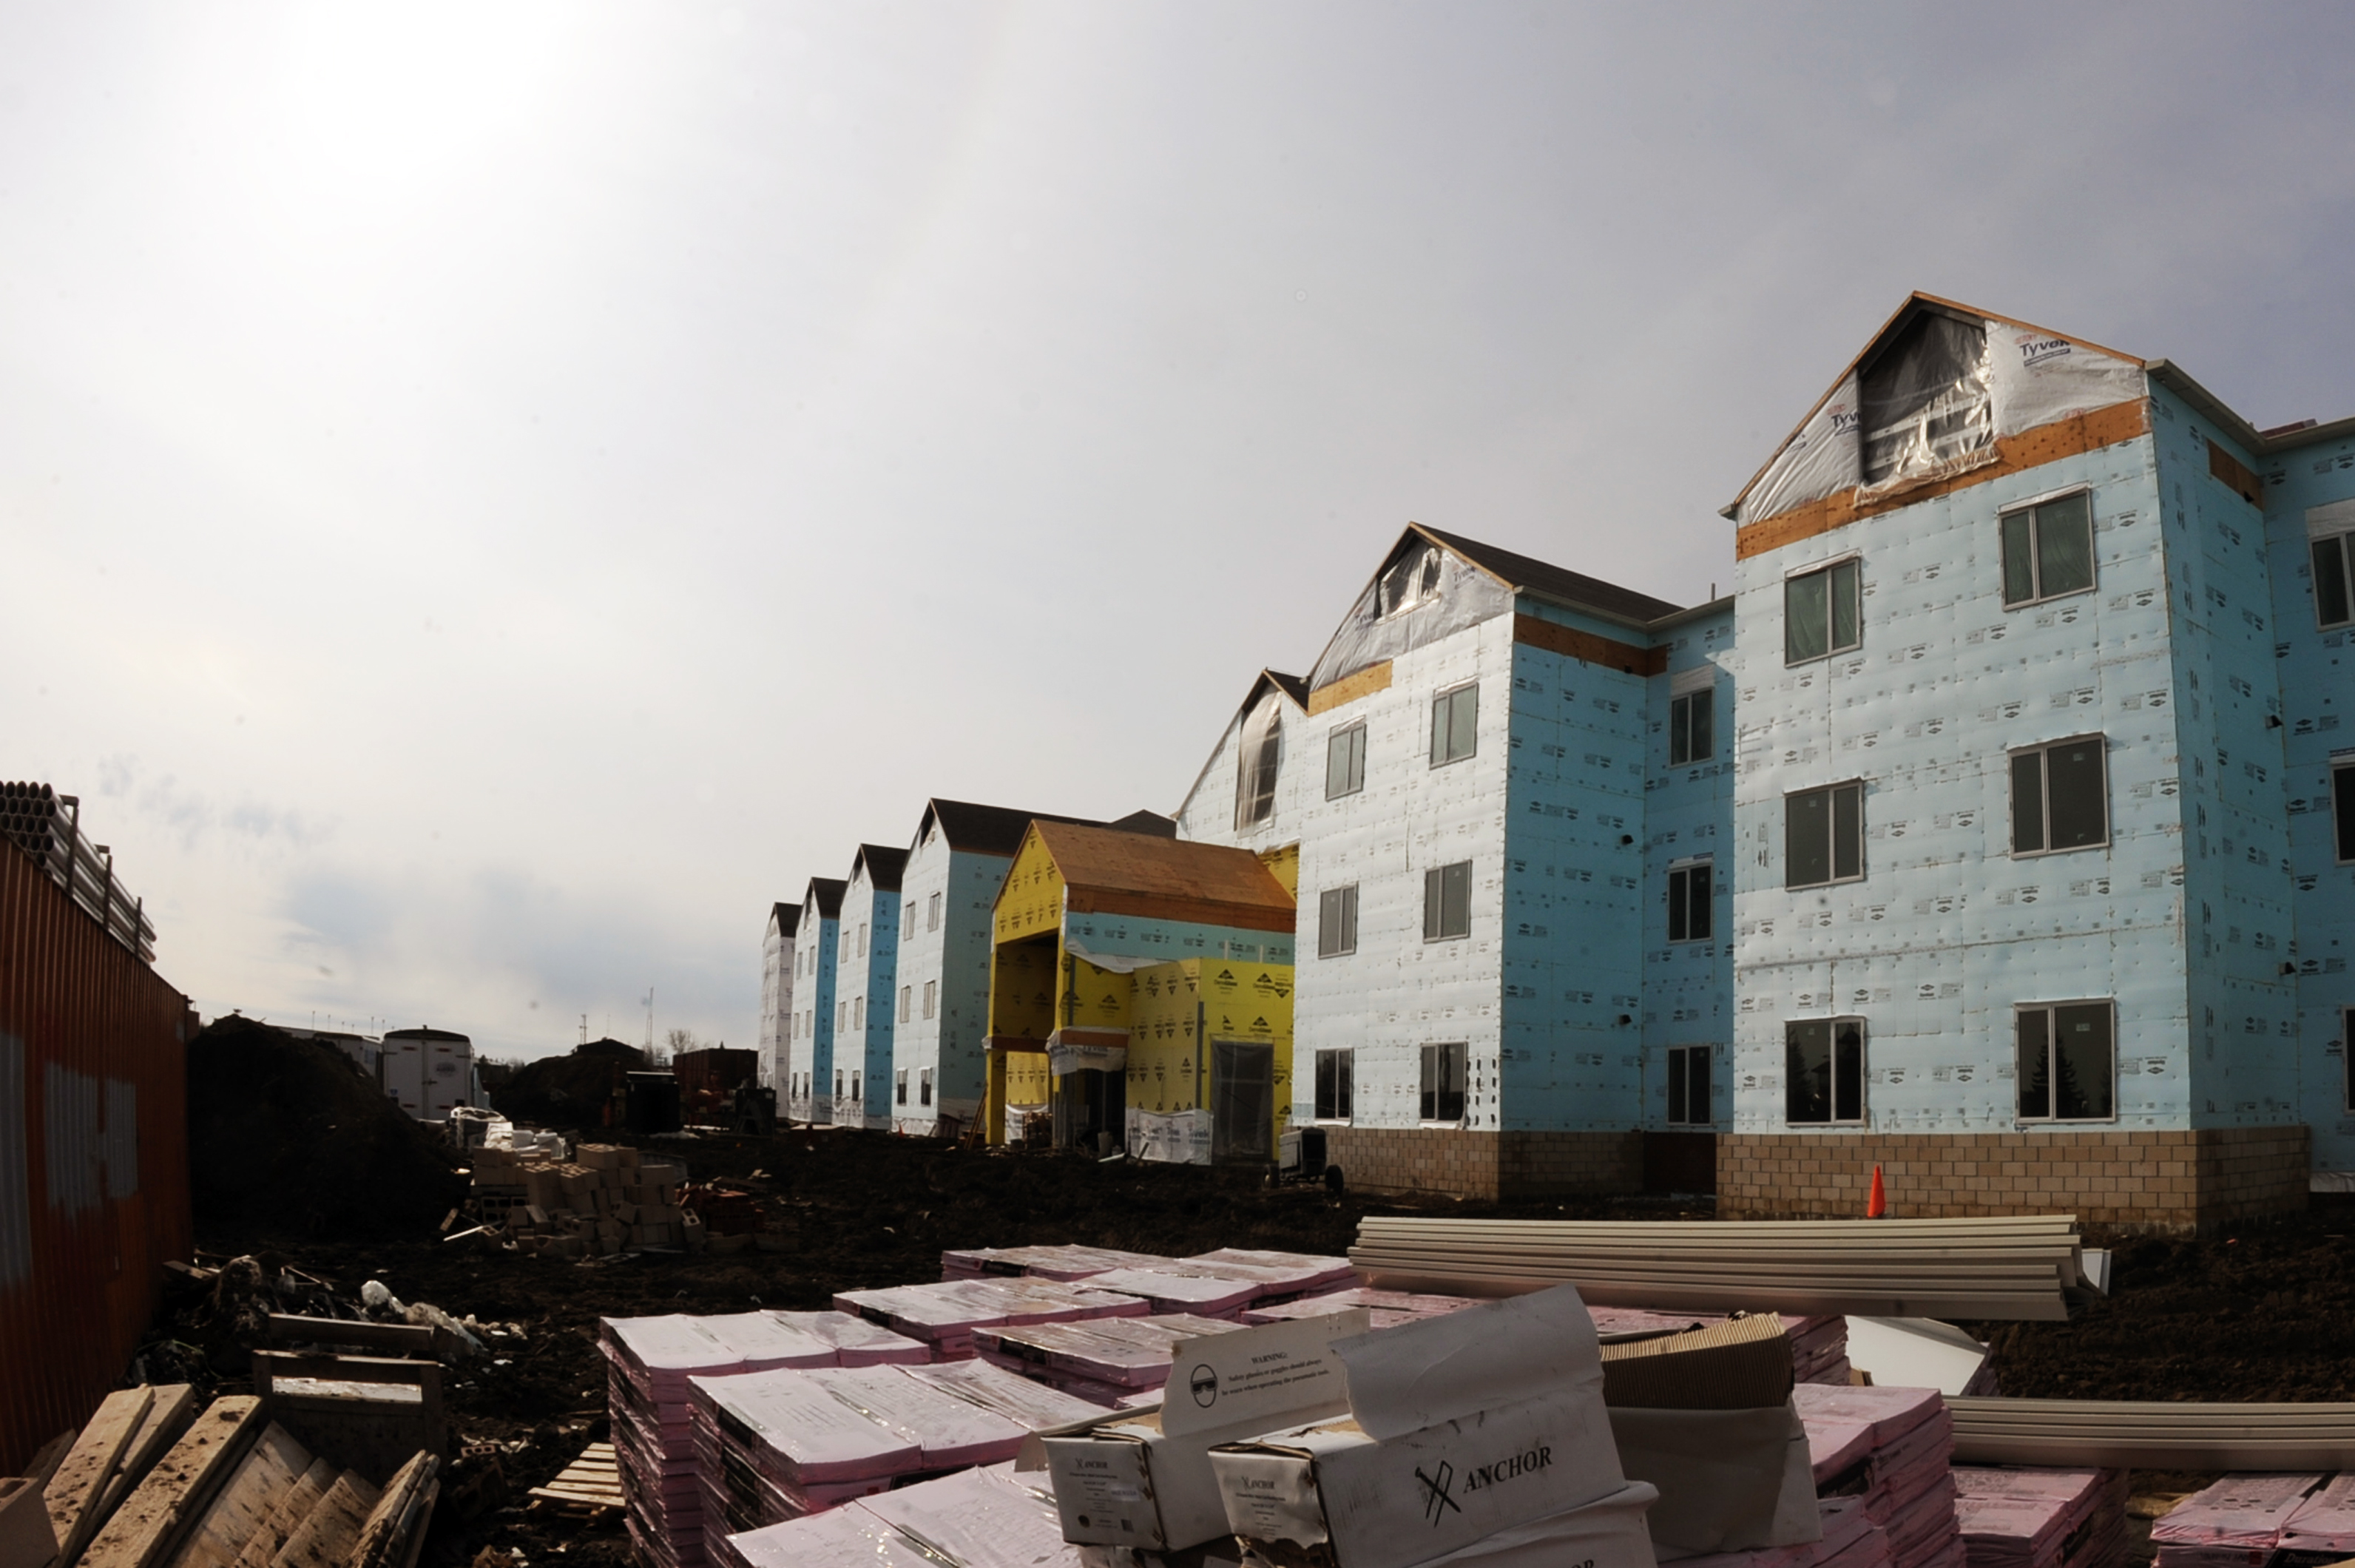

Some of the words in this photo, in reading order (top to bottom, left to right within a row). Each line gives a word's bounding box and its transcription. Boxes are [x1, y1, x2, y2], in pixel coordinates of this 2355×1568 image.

[1251, 1352, 1288, 1364] WARNING:
[1228, 1374, 1245, 1382] Safety
[1246, 1371, 1263, 1380] glasses
[1271, 1365, 1288, 1375] goggles
[1289, 1361, 1305, 1369] should
[1258, 1379, 1283, 1389] operating
[1084, 1459, 1108, 1469] ANCHOR
[1463, 1446, 1552, 1494] ANCHOR
[1251, 1479, 1275, 1490] ANCHOR
[2284, 1552, 2336, 1564] Duration
